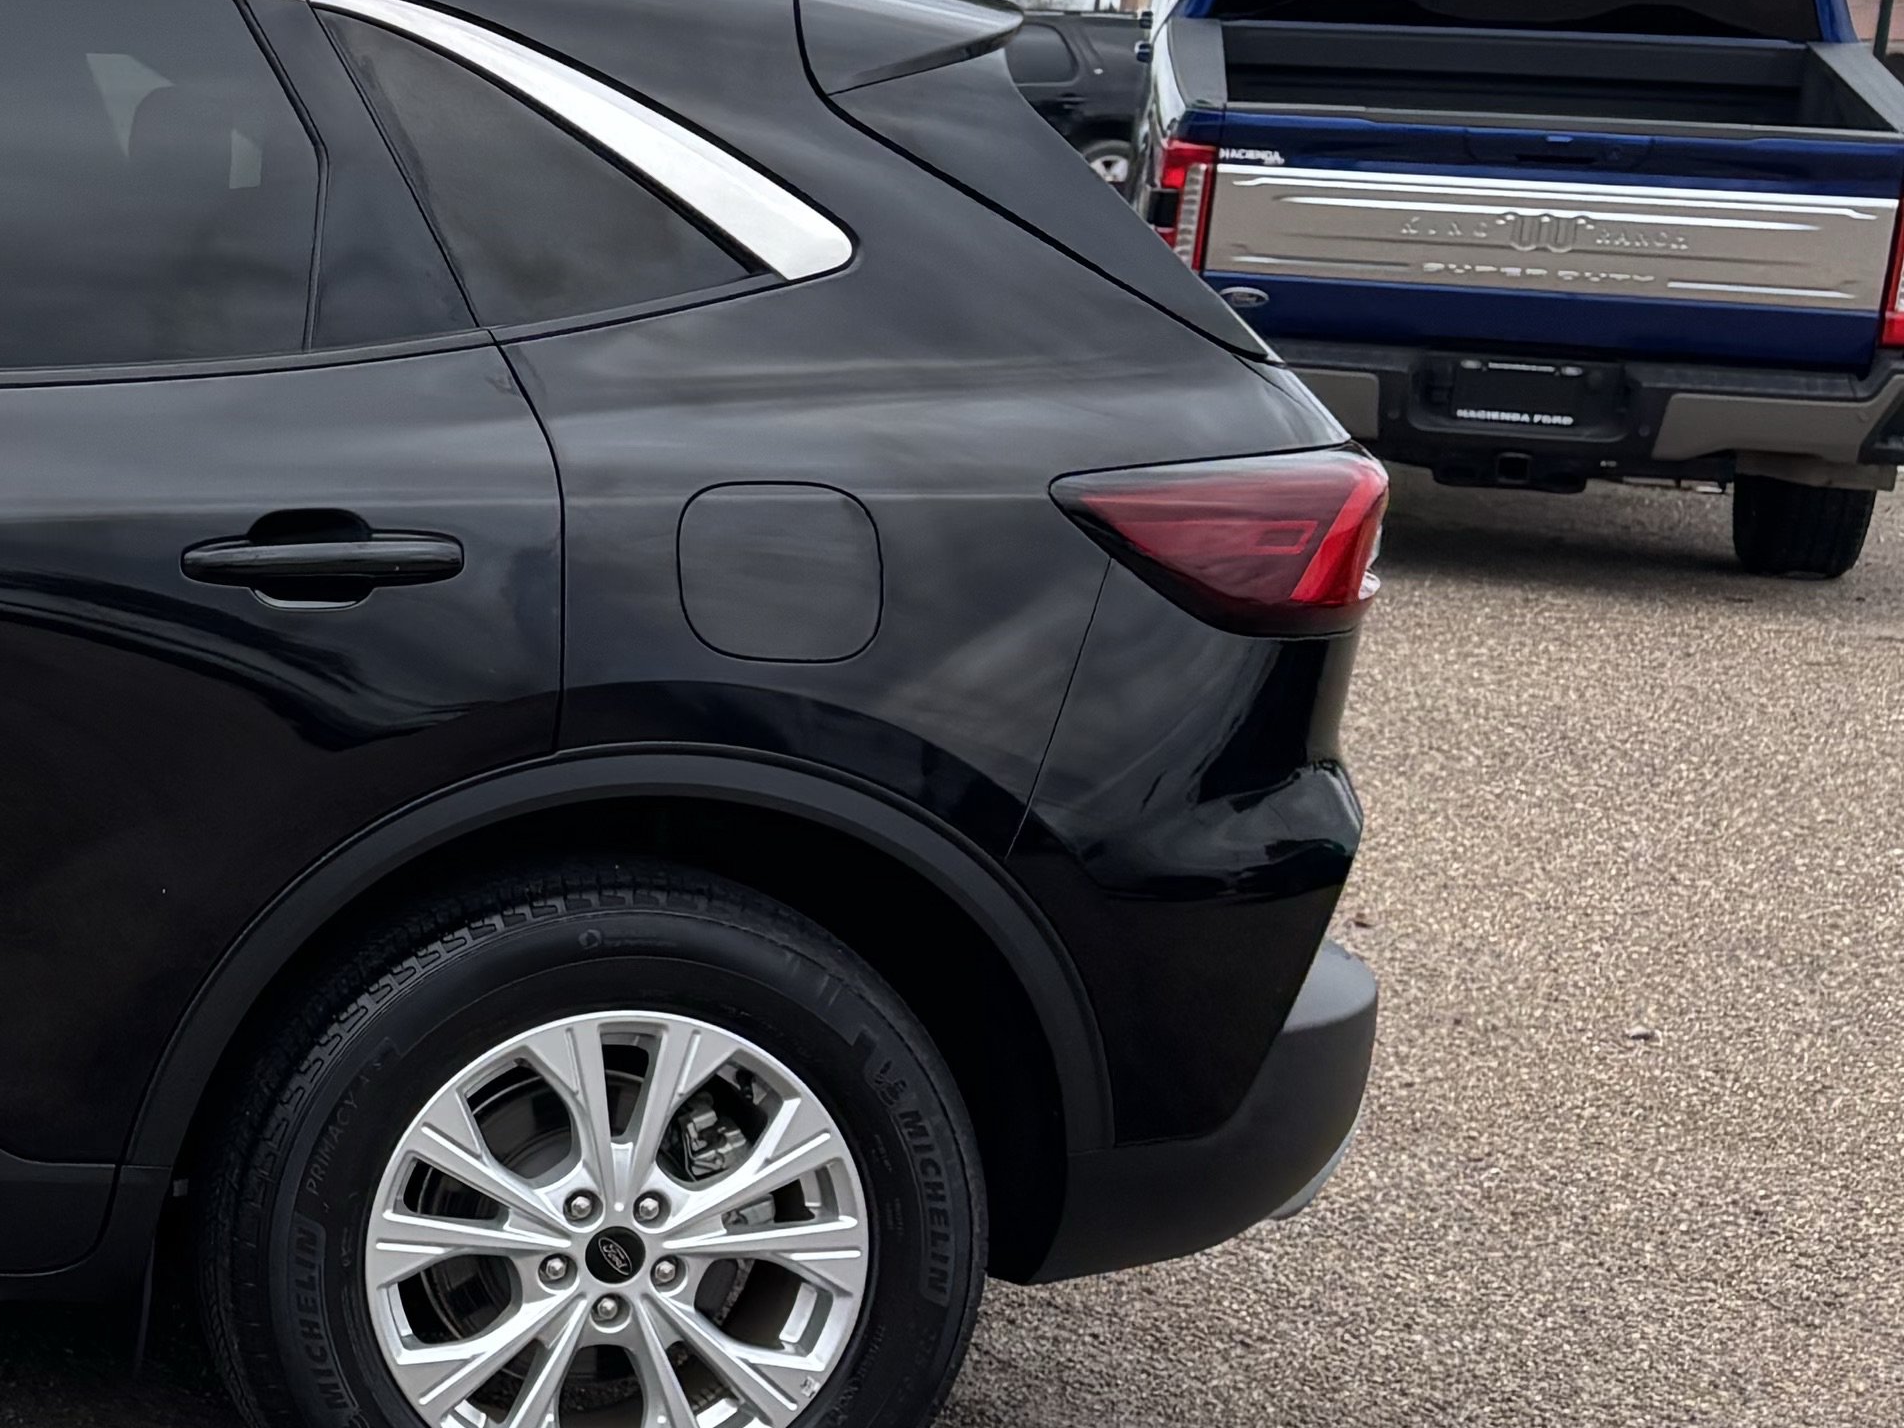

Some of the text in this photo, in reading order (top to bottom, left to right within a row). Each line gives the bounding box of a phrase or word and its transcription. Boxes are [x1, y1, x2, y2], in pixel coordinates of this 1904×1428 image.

[306, 1088, 358, 1196] PRIMACY
[899, 1109, 951, 1296] MICHELIN
[294, 1225, 349, 1410] MICHELIN
